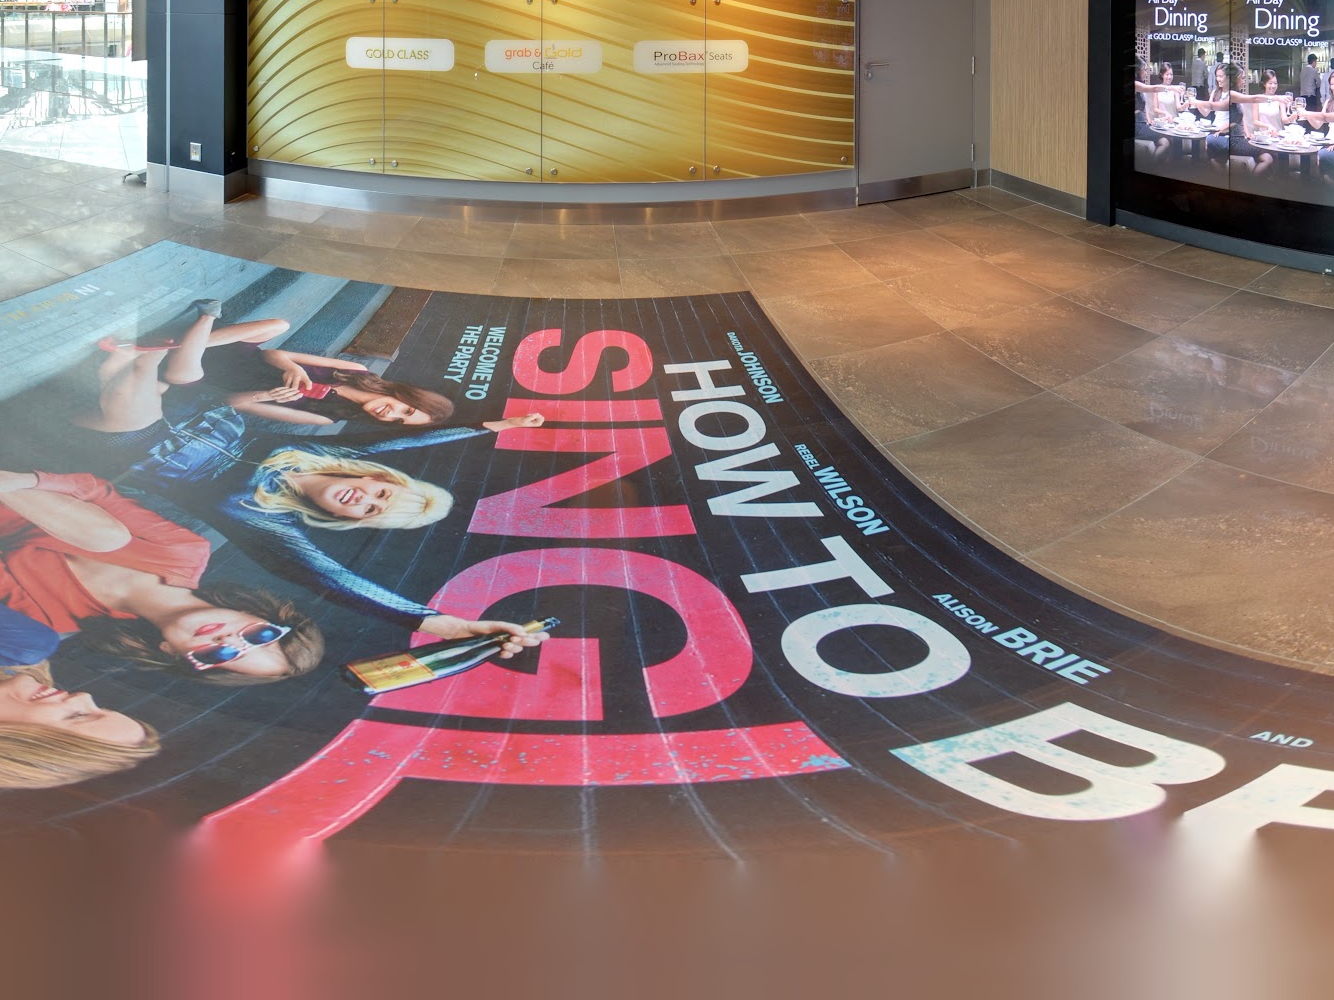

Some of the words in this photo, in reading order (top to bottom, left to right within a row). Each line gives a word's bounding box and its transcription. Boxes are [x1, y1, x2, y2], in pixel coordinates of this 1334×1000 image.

[1154, 6, 1208, 33] Dining
[1254, 8, 1320, 37] Dining
[1153, 33, 1171, 41] GOLD
[1194, 34, 1215, 43] Lounge
[1253, 37, 1275, 46] GOLD
[1303, 40, 1329, 49] Lounge
[365, 48, 395, 59] GOLD
[397, 49, 429, 60] CLASS
[504, 47, 532, 60] grab
[534, 49, 541, 58] &
[544, 46, 582, 59] Gold
[709, 51, 733, 61] Seats
[532, 60, 554, 70] Café
[74, 284, 101, 297] IN
[460, 325, 483, 345] THE
[443, 345, 475, 384] PARTY
[471, 326, 506, 381] WELCOME
[726, 331, 743, 351] DAKOTA
[738, 351, 784, 404] JOHNSON
[465, 383, 489, 400] TO
[663, 359, 825, 518] HOW
[794, 443, 821, 470] REBEL
[814, 466, 890, 536] WILSON
[201, 328, 851, 842] SINGL
[740, 534, 971, 698] TO
[932, 592, 1000, 634] ALISON
[992, 627, 1112, 685] BRIE
[1249, 730, 1313, 748] AND
